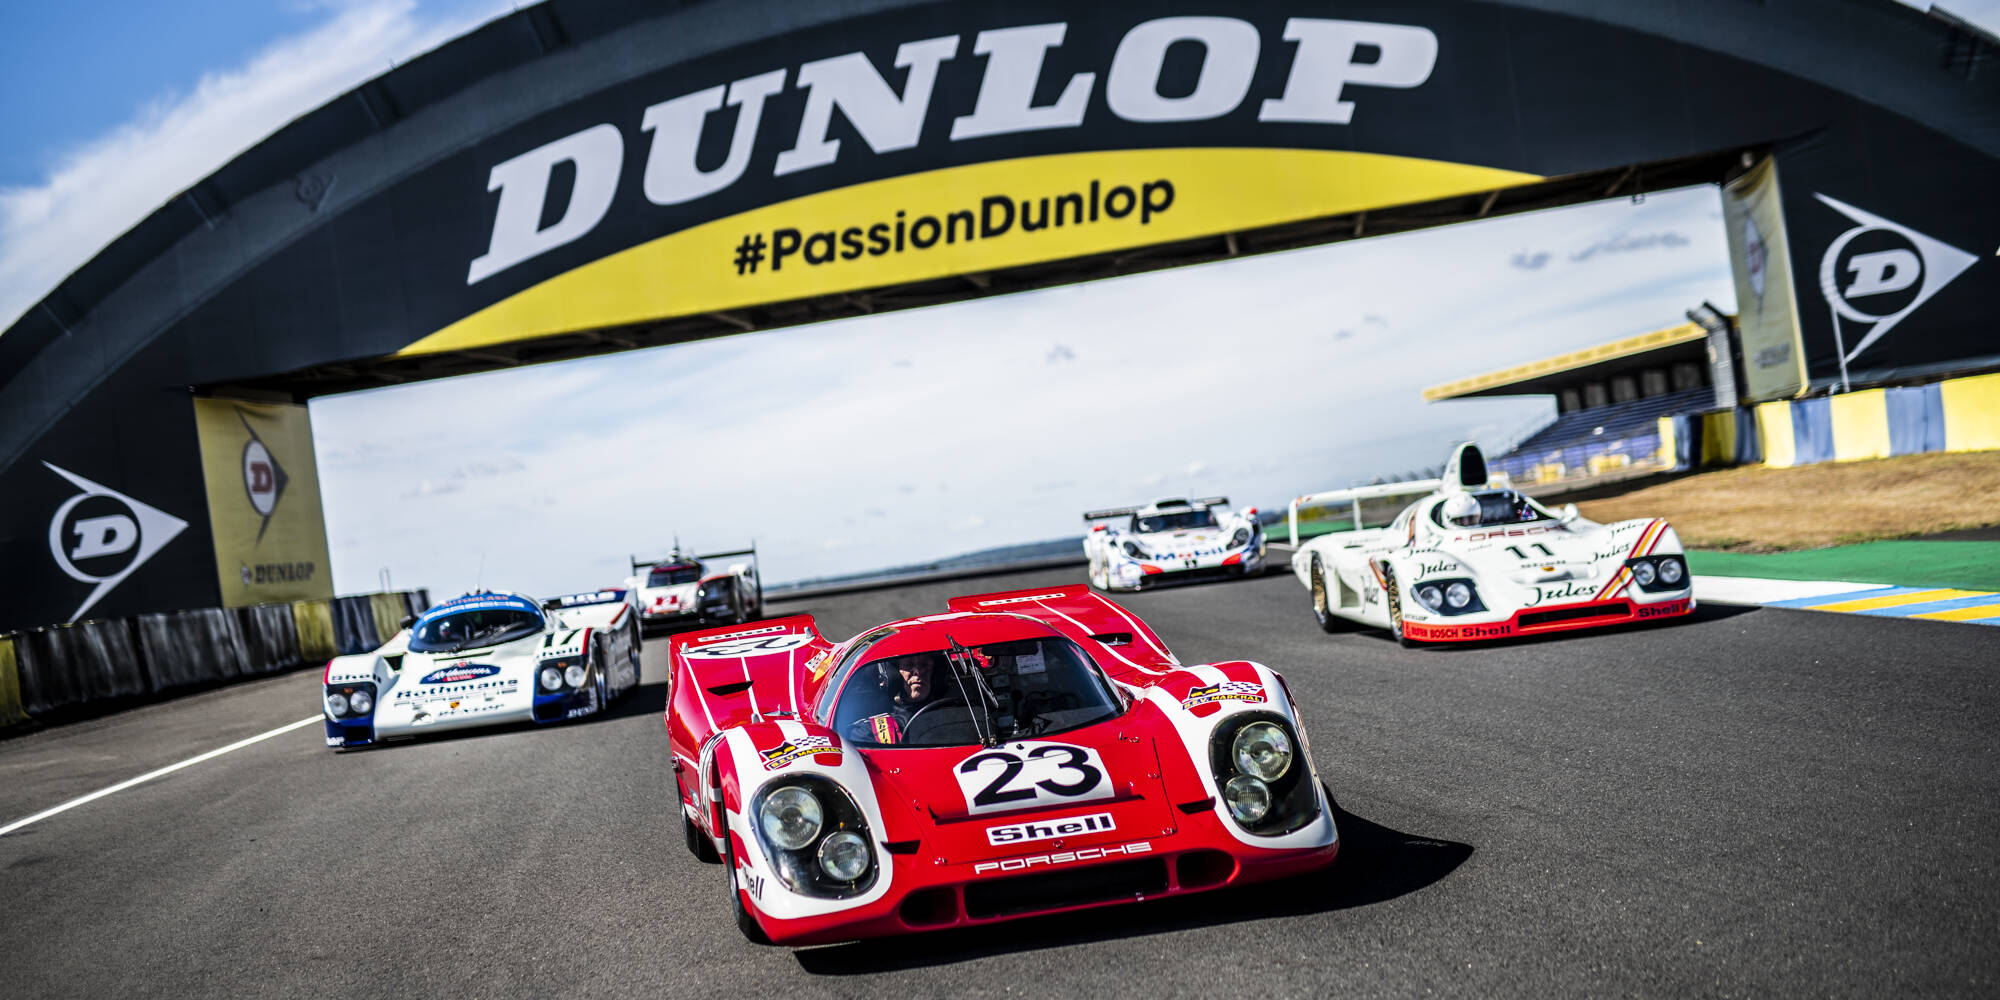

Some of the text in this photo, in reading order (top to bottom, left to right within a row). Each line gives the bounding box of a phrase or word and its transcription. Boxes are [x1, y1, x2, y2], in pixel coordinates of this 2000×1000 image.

[467, 16, 1439, 285] DUNLOP
[734, 178, 1176, 276] #PassionDunlop
[1845, 248, 1921, 298] D
[71, 514, 138, 560] D
[1505, 543, 1554, 559] 11
[254, 561, 315, 585] DUNLOP
[1413, 561, 1457, 581] Jules
[1524, 583, 1598, 607] Jules
[1637, 603, 1680, 617] Shell
[543, 628, 582, 648] 17
[1430, 628, 1458, 639] BOSCH
[1462, 625, 1512, 638] Shell
[396, 679, 519, 699] Rothmans
[1211, 694, 1261, 702] MARCHAL
[960, 745, 1103, 807] 23
[991, 815, 1112, 843] Shell
[974, 842, 1153, 874] PORSCHE
